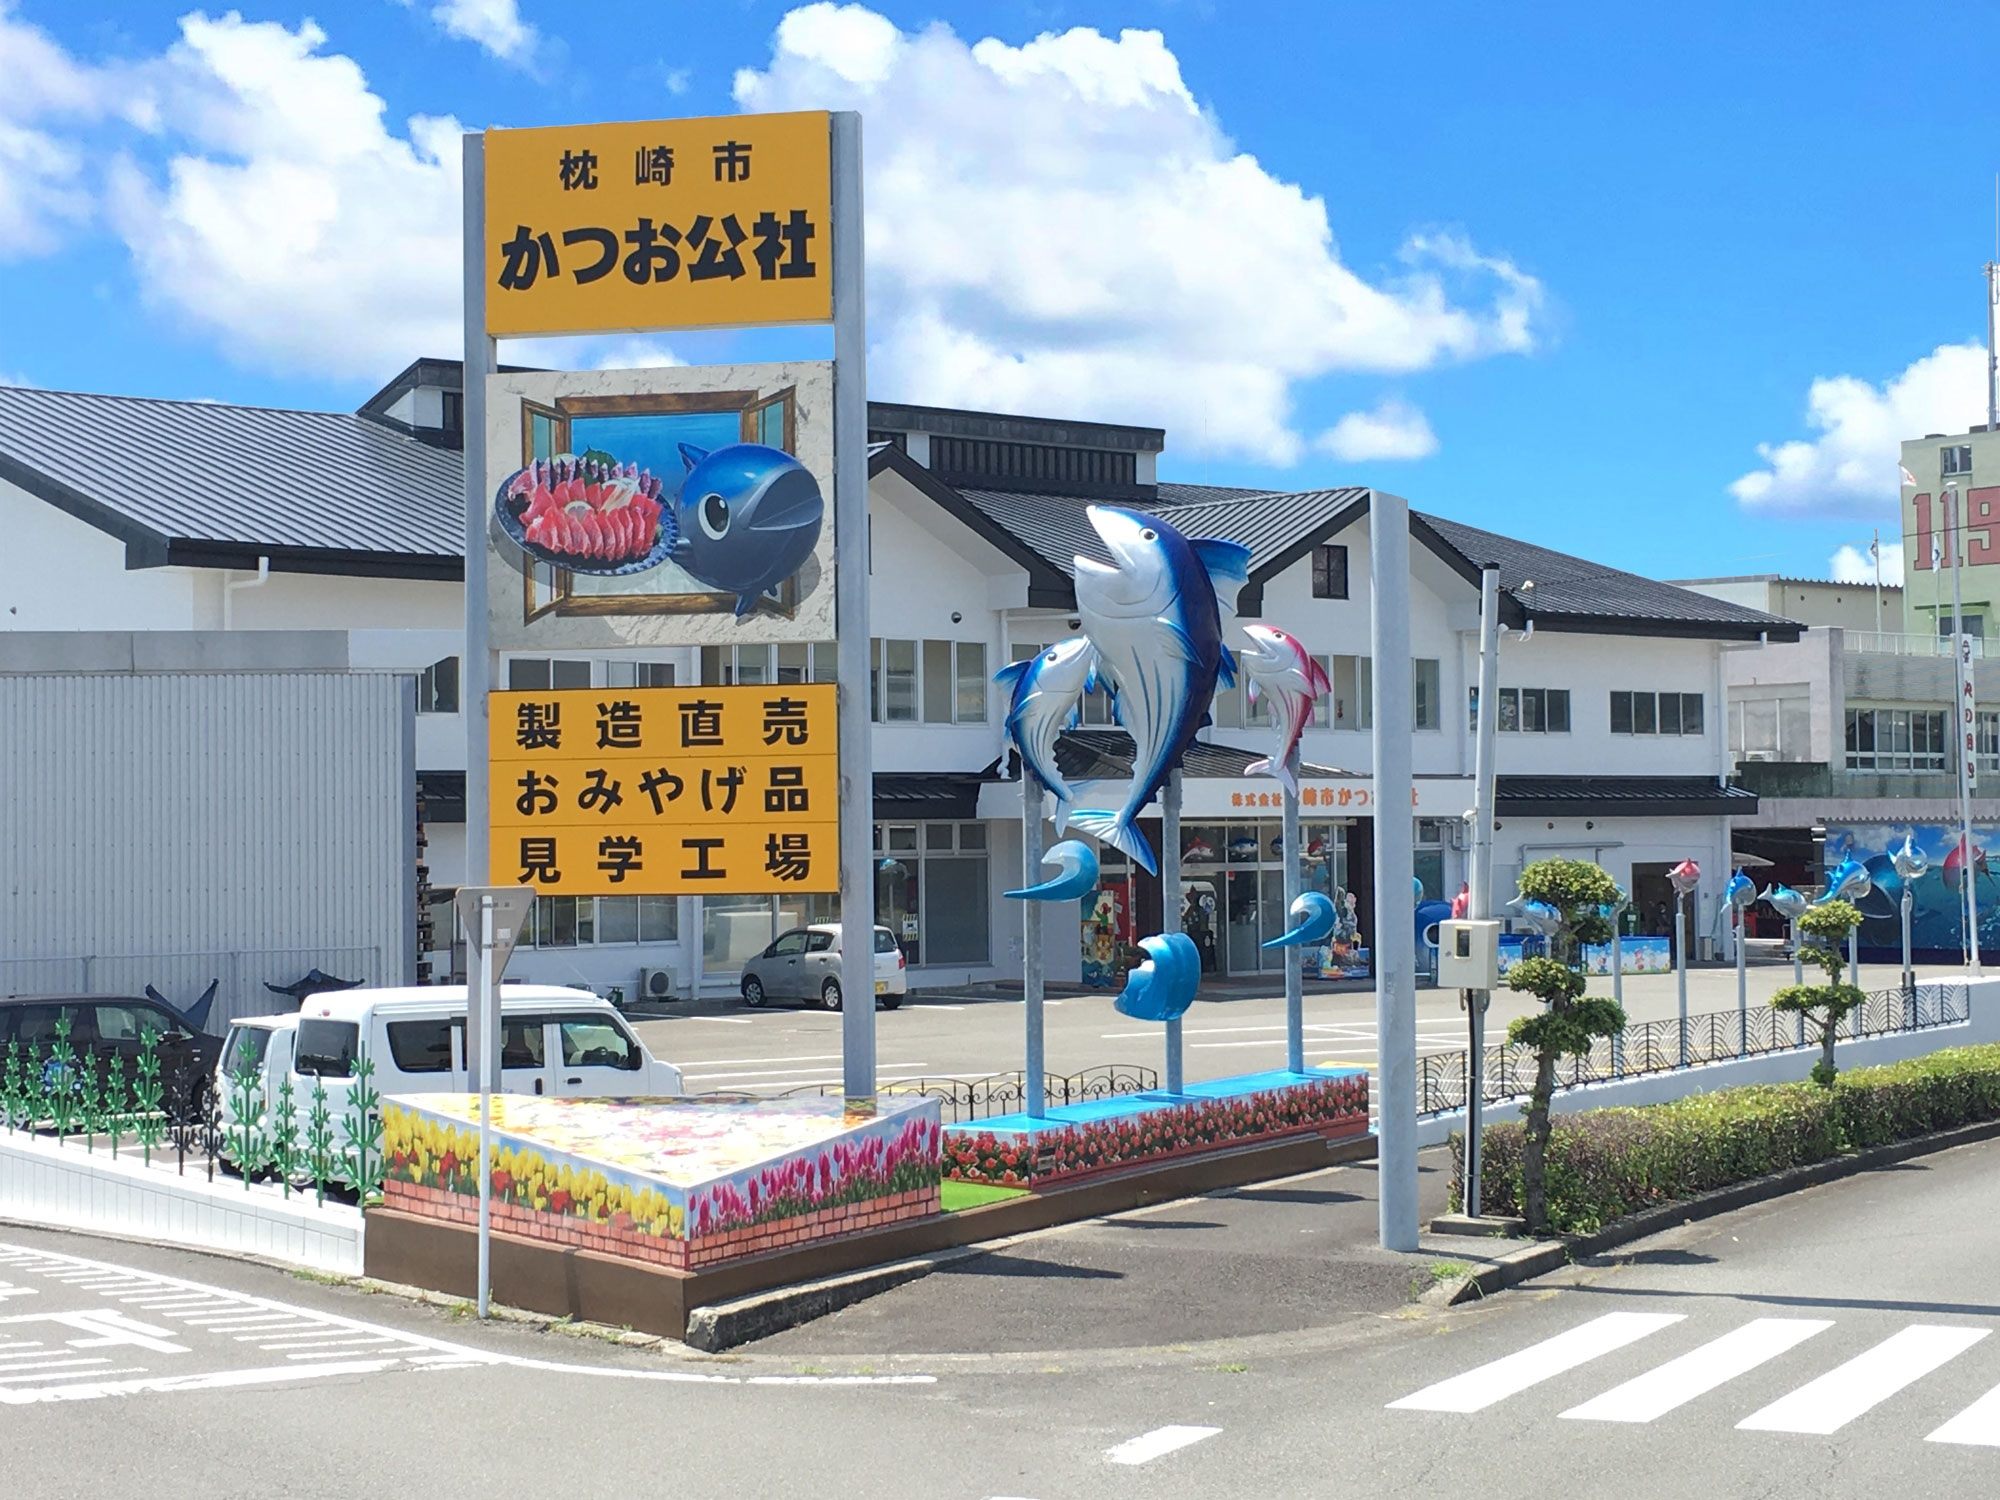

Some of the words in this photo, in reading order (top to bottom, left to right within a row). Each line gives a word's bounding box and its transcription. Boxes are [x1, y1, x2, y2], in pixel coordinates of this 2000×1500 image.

[560, 141, 752, 190] 枕崎市
[498, 210, 815, 290] かつお公社
[517, 697, 808, 749] 製造直売
[517, 767, 808, 815] おみやげ品
[518, 834, 810, 884] 見学工場
